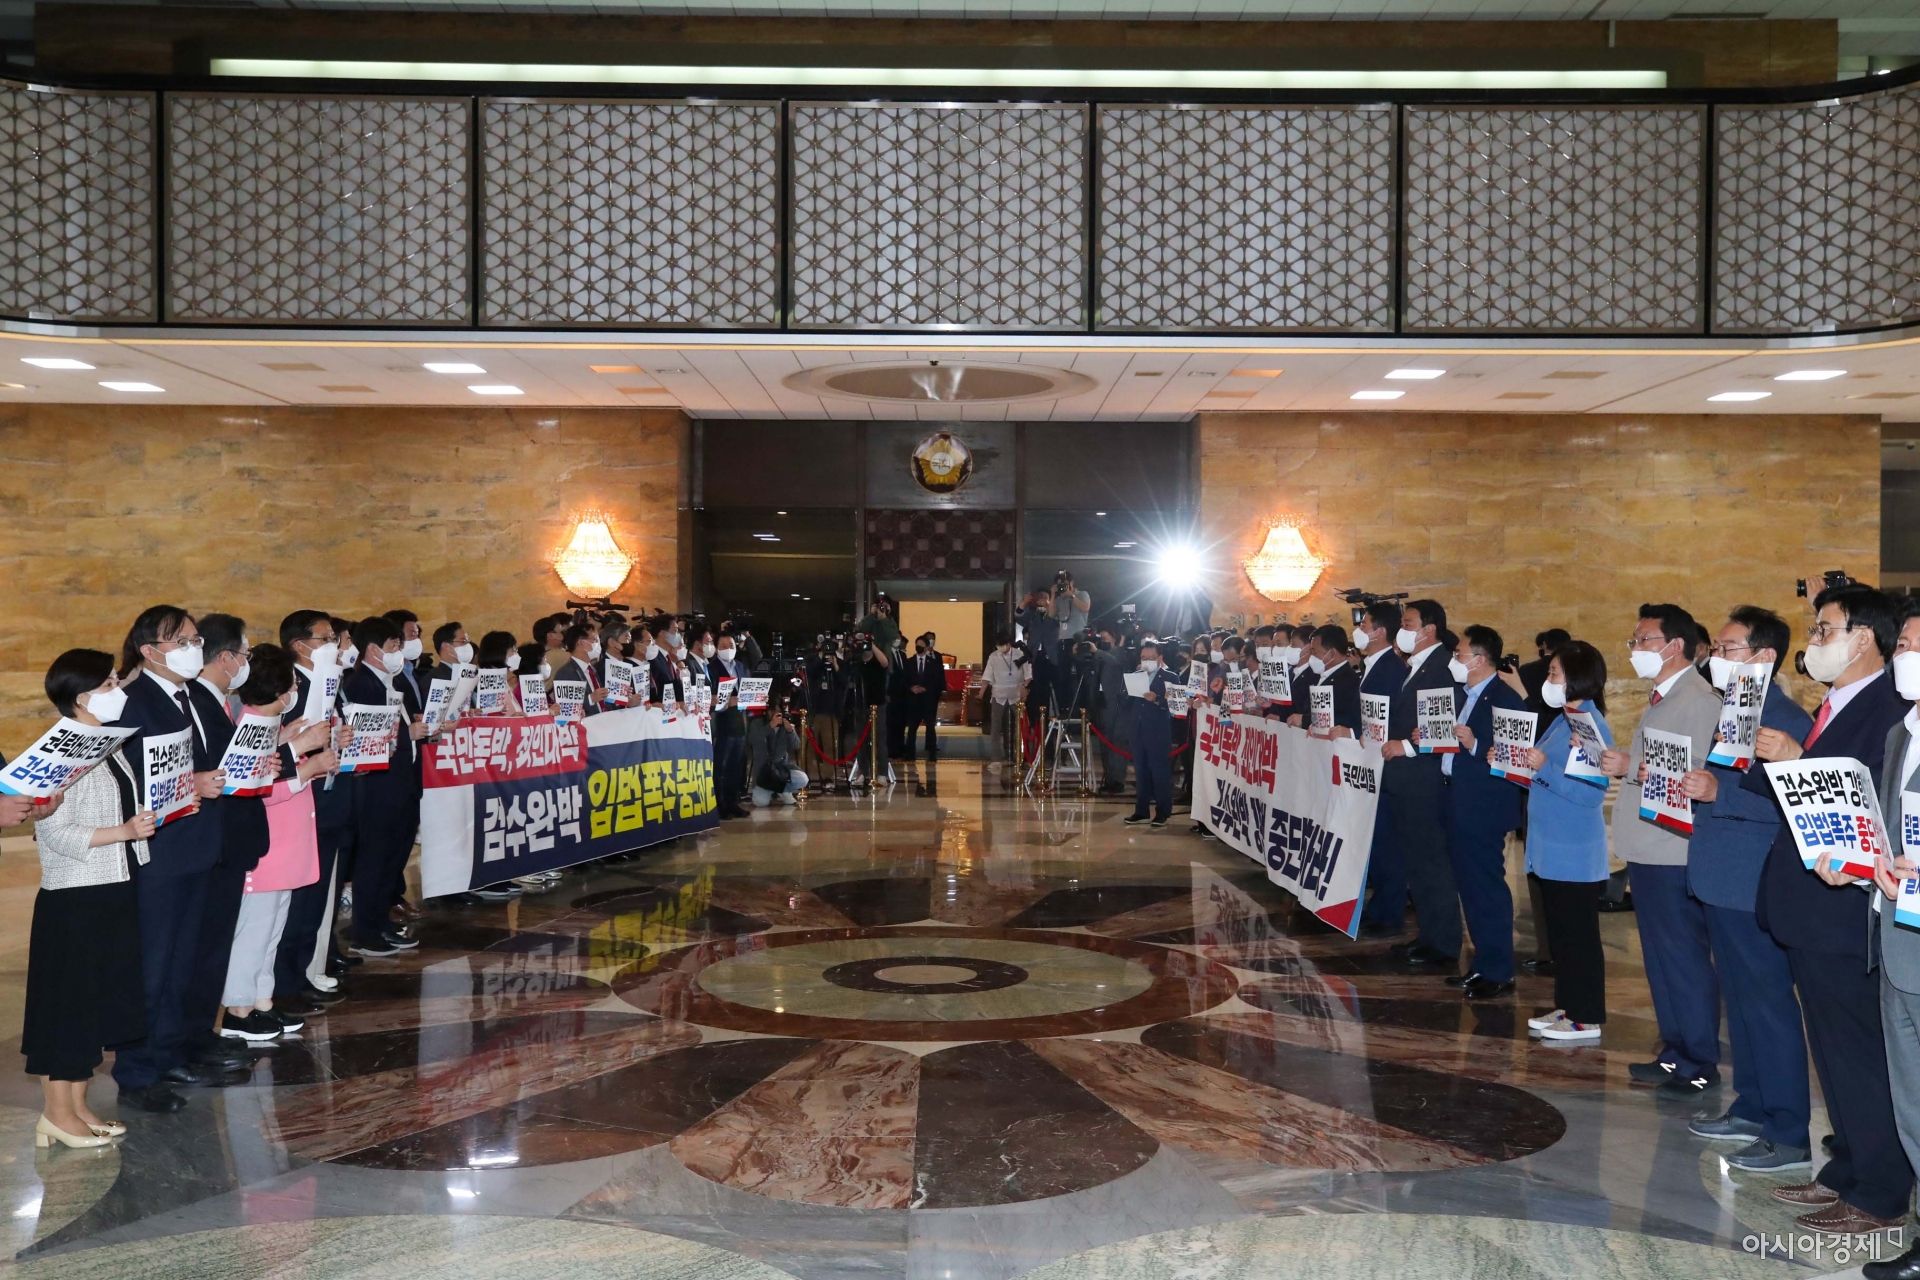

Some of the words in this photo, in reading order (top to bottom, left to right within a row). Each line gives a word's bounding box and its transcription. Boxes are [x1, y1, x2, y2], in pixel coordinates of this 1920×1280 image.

[1365, 699, 1387, 720] 은폐시도
[39, 728, 102, 760] 권력비리
[234, 723, 267, 750] 이재명
[1508, 718, 1532, 743] 강행처리
[149, 743, 181, 777] 검수완박
[224, 753, 257, 780] 민주당은
[436, 726, 513, 776] 국민독박,
[516, 723, 579, 769] 죄인대박
[1644, 737, 1665, 769] 검수완박
[1665, 742, 1688, 774] 강행처리
[9, 755, 75, 789] 검수완박
[1342, 762, 1376, 794] 국민의힘
[1776, 770, 1849, 807] 검수완박
[483, 784, 583, 864] 검수완박
[588, 759, 676, 840] 입법폭주
[1210, 778, 1252, 847] 검수완박
[1795, 811, 1857, 850] 입법폭주
